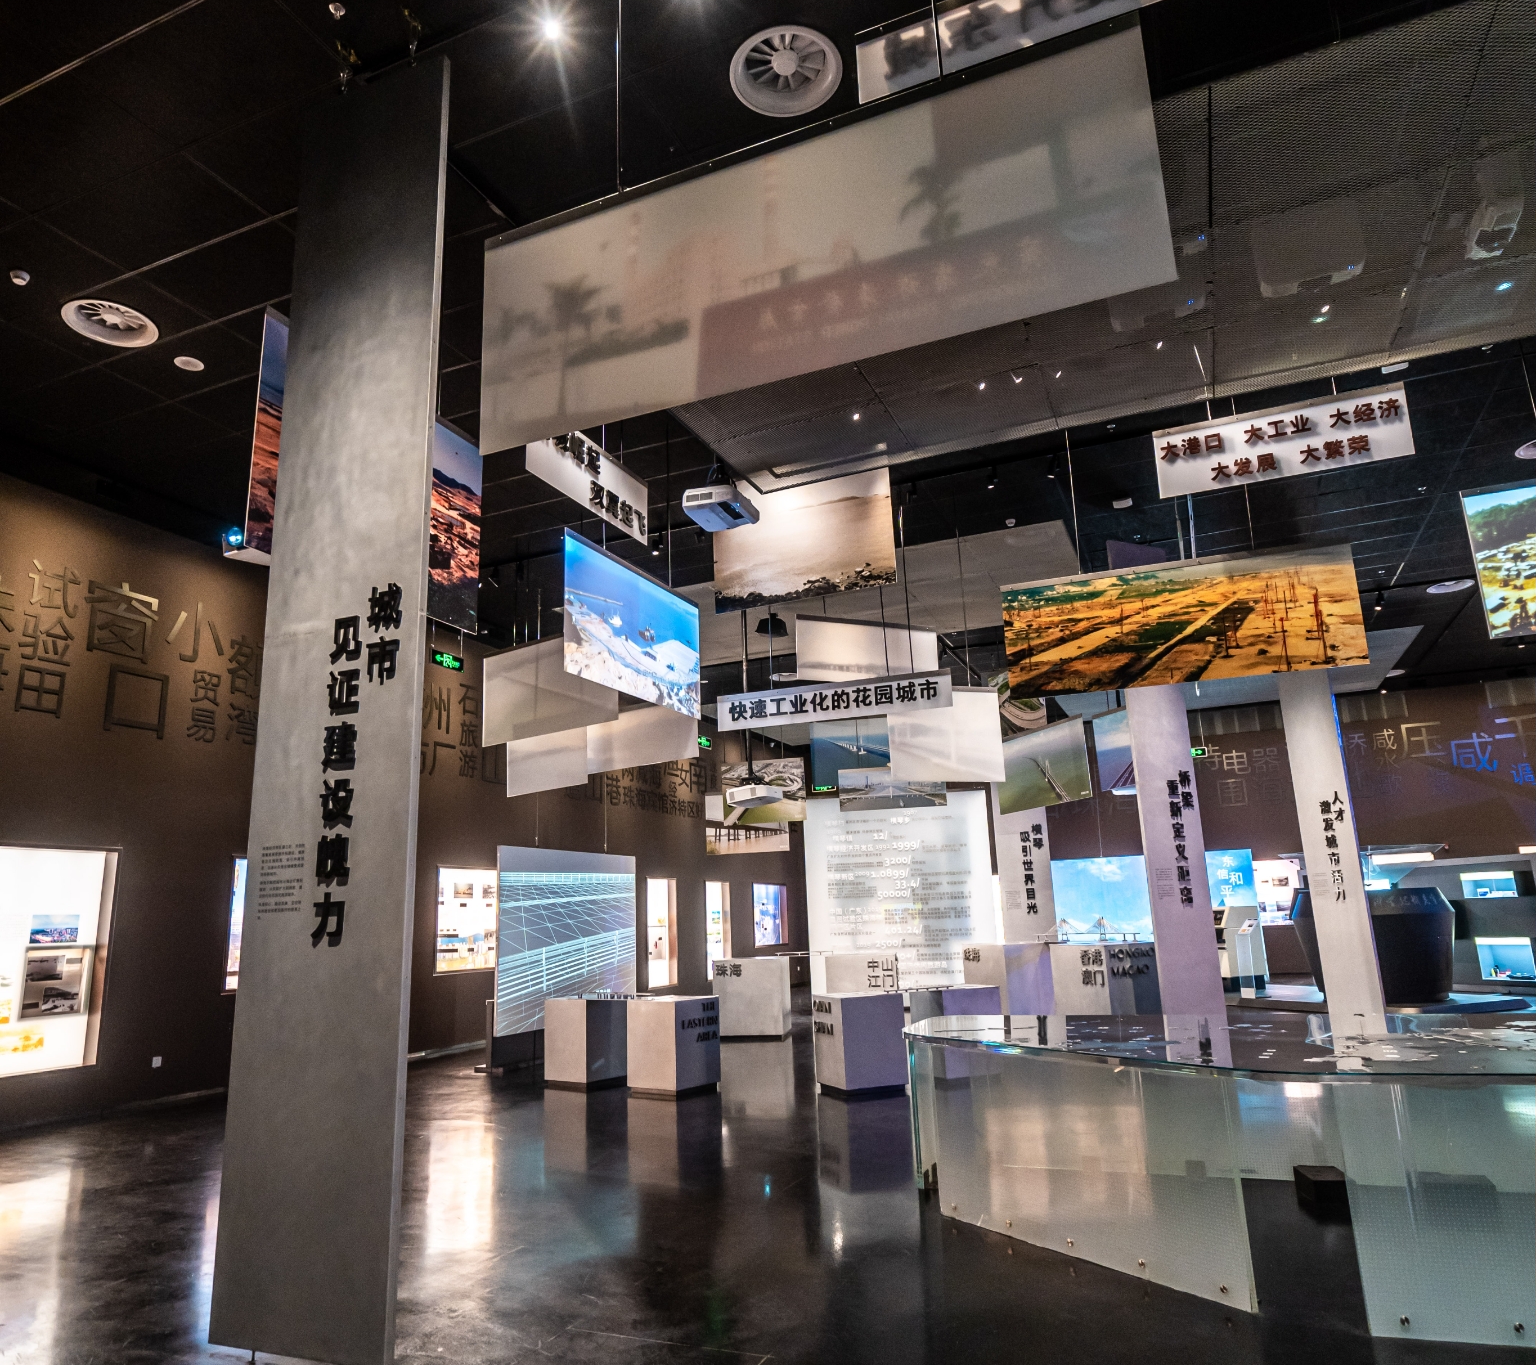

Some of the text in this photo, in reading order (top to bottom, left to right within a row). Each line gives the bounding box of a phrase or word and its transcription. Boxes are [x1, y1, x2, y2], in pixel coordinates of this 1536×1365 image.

[1160, 398, 1401, 461] 大港口 大工业 大经济
[1211, 435, 1371, 481] 大发展 大繁荣
[366, 582, 403, 686] 城市
[84, 580, 170, 740] 窗口
[729, 679, 939, 722] 快速工业化的花园城市
[1331, 791, 1345, 822] 人才
[1019, 831, 1038, 914] 吸引世界目光
[1319, 800, 1346, 901] 激发城市活力
[715, 963, 742, 978] 珠海
[867, 958, 893, 973] 中山
[867, 974, 895, 988] 江门
